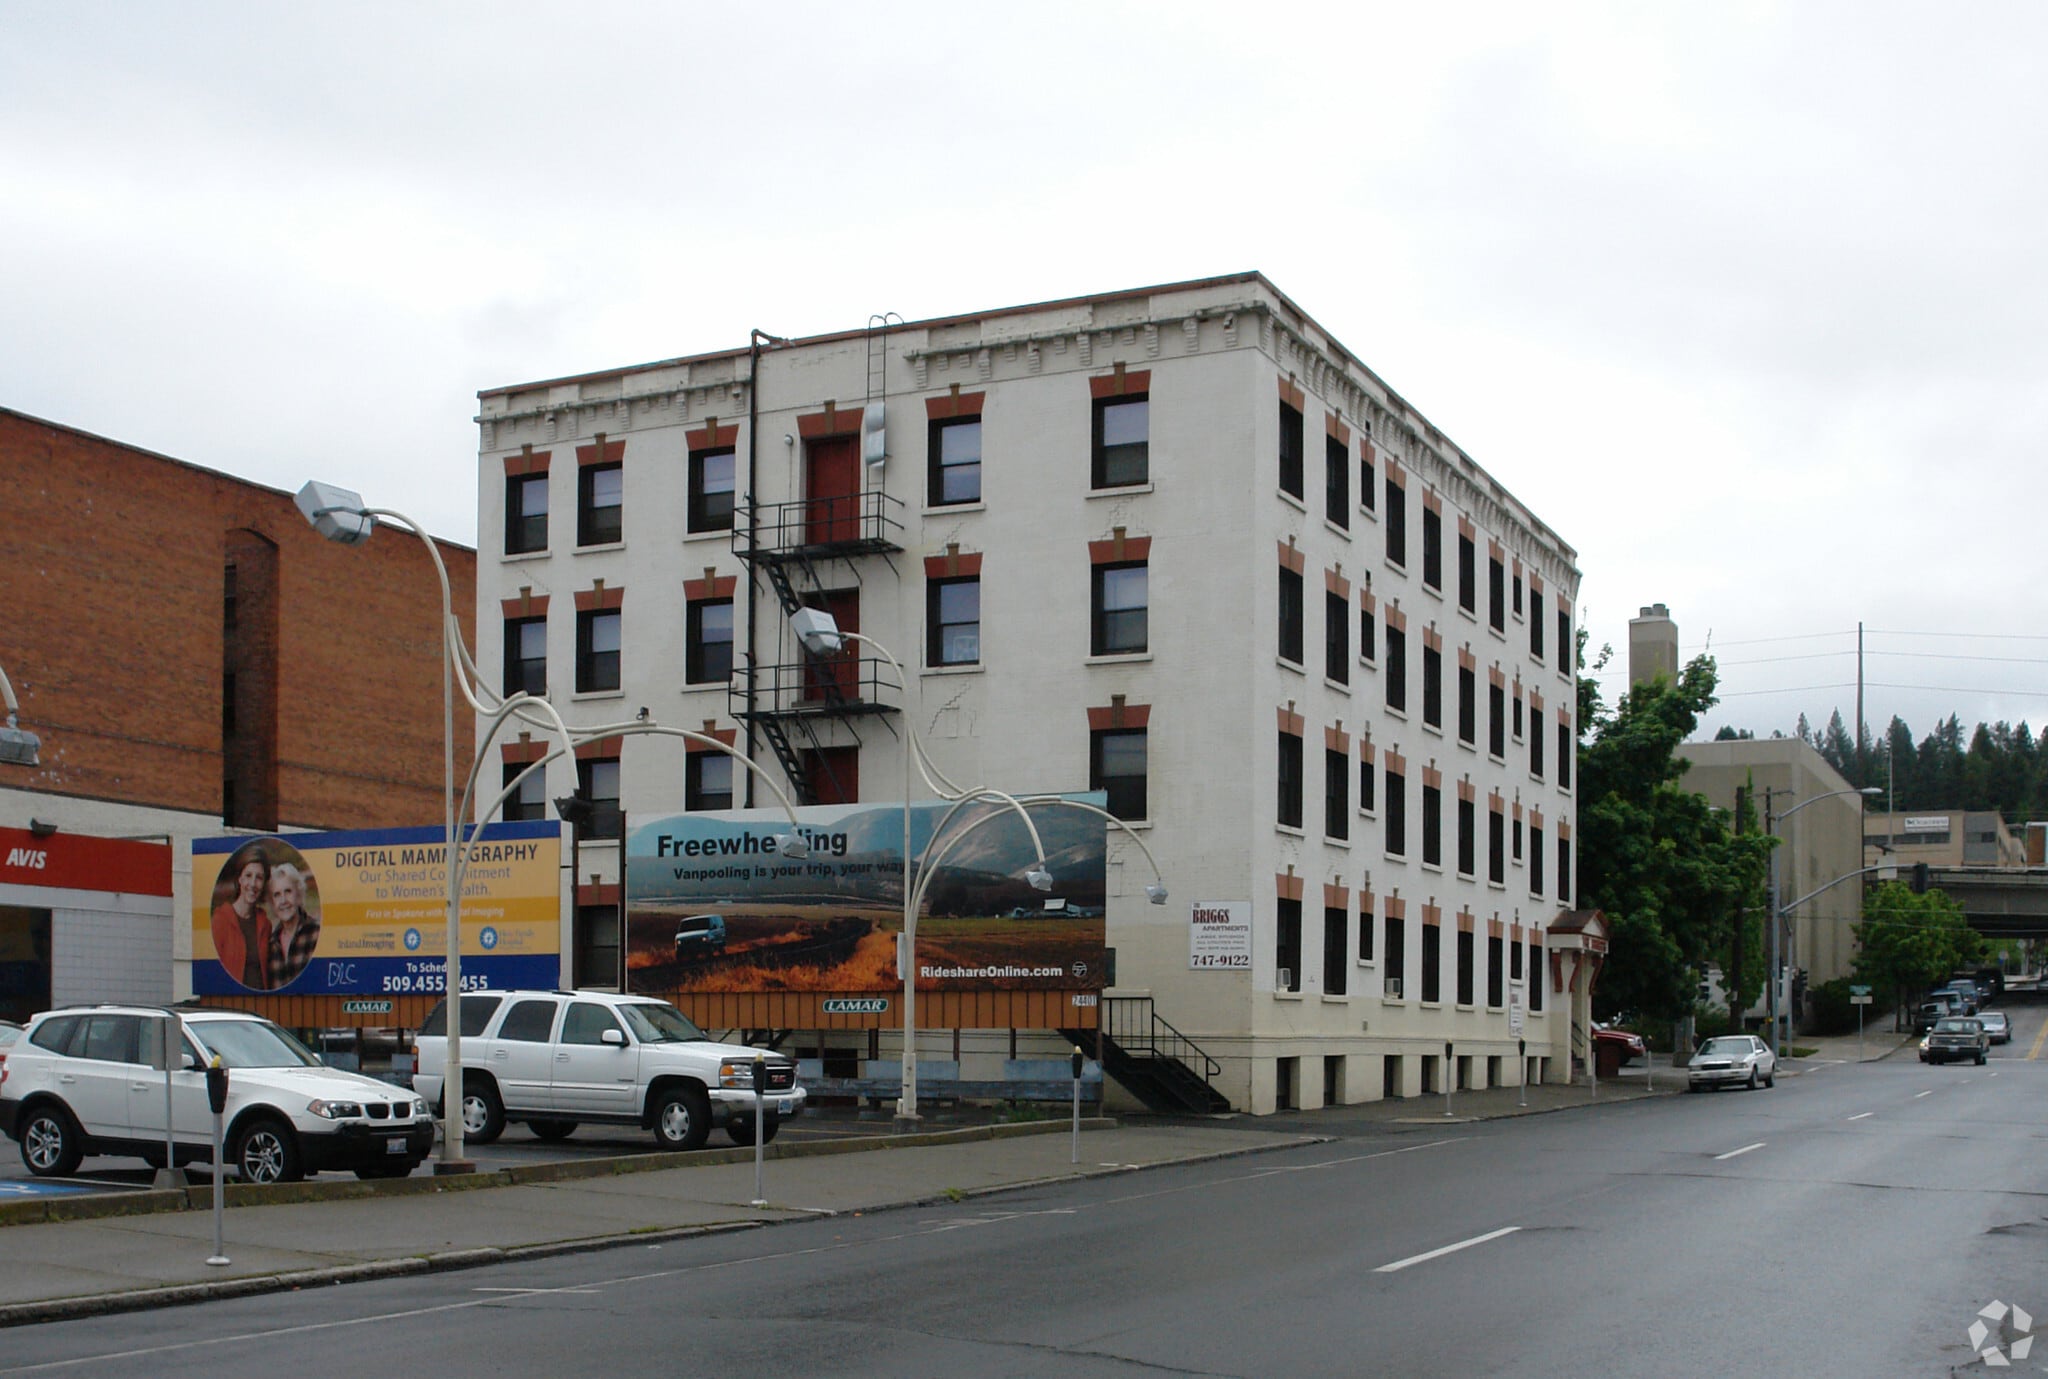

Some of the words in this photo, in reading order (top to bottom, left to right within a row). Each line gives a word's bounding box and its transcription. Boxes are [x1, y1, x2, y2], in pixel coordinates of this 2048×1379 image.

[658, 829, 847, 857] Freewheing
[6, 848, 47, 869] AVIS
[336, 850, 396, 868] DIGITAL
[401, 844, 538, 865] MAMGRAPHY
[360, 870, 381, 883] Our
[385, 868, 426, 882] Shared
[430, 867, 510, 881] Coitment
[674, 866, 750, 881] Vanpooling
[755, 865, 766, 877] is
[771, 865, 802, 879] your
[806, 863, 835, 877] trip,
[841, 862, 873, 877] your
[376, 887, 388, 898] to
[392, 884, 445, 898] Women's
[1192, 909, 1230, 924] BRIGGS
[406, 963, 417, 973] To
[420, 962, 462, 973] Sched
[1192, 955, 1249, 966] 747-9122
[920, 966, 1063, 978] RideshareOnline.com
[382, 975, 489, 991] 509.455.455
[346, 1002, 388, 1012] LAMAR
[828, 1000, 881, 1011] LAMAR
